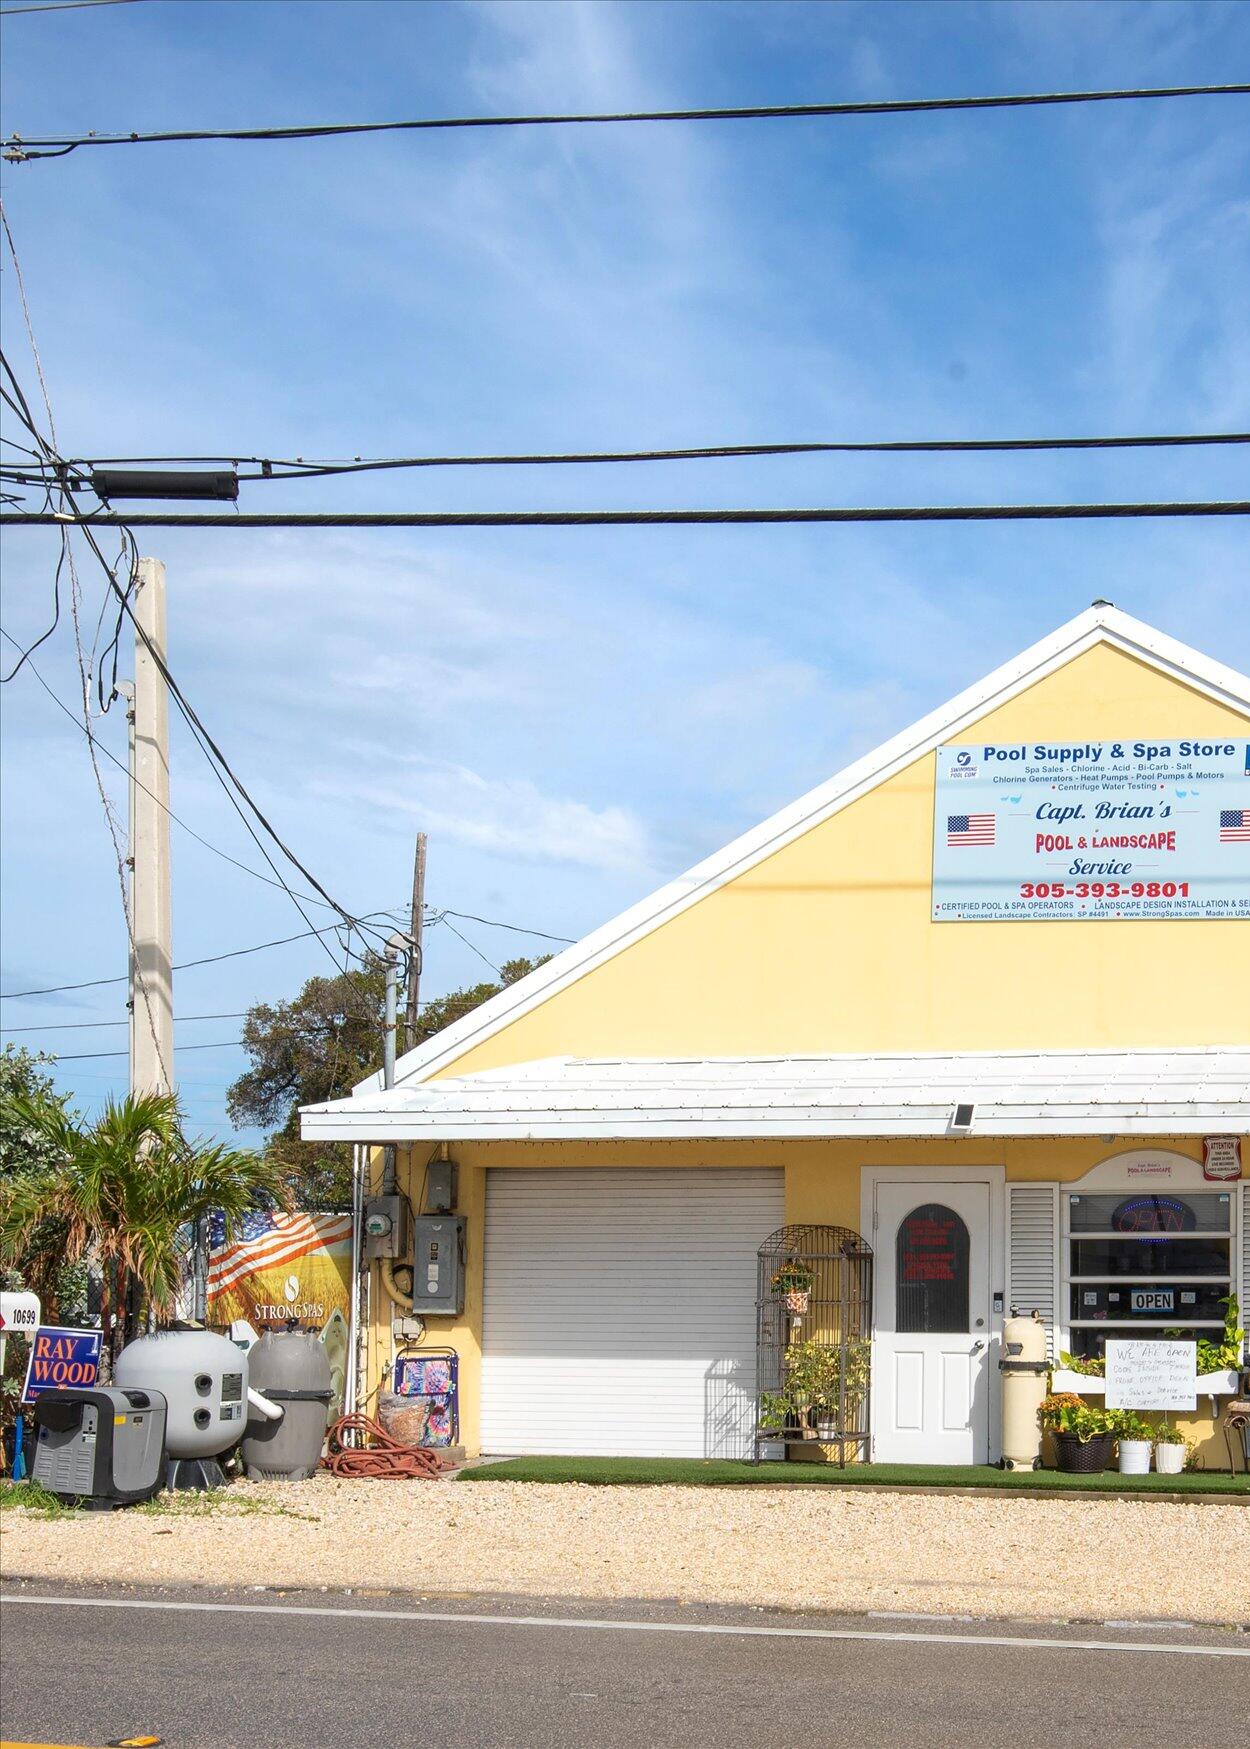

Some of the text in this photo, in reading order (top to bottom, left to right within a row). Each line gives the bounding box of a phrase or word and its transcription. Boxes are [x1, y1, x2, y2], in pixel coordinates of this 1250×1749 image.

[984, 742, 1235, 762] Pool Supply & Spa Store
[1102, 774, 1128, 782] Pumps
[1157, 773, 1185, 781] Pumps
[1058, 783, 1099, 792] Centrifuge
[1128, 783, 1157, 791] Testing
[1036, 801, 1173, 824] Capt. Brian's
[1036, 830, 1176, 853] POOL & LANDSCAPE
[1069, 857, 1132, 875] Service
[1020, 882, 1189, 898] 305-393-9801
[942, 902, 980, 911] CERTIFIED
[1119, 1210, 1184, 1232] OPEN
[1136, 1294, 1171, 1308] OPEN
[13, 1309, 35, 1324] 10699
[36, 1337, 79, 1359] RAY
[34, 1360, 95, 1384] WOOD
